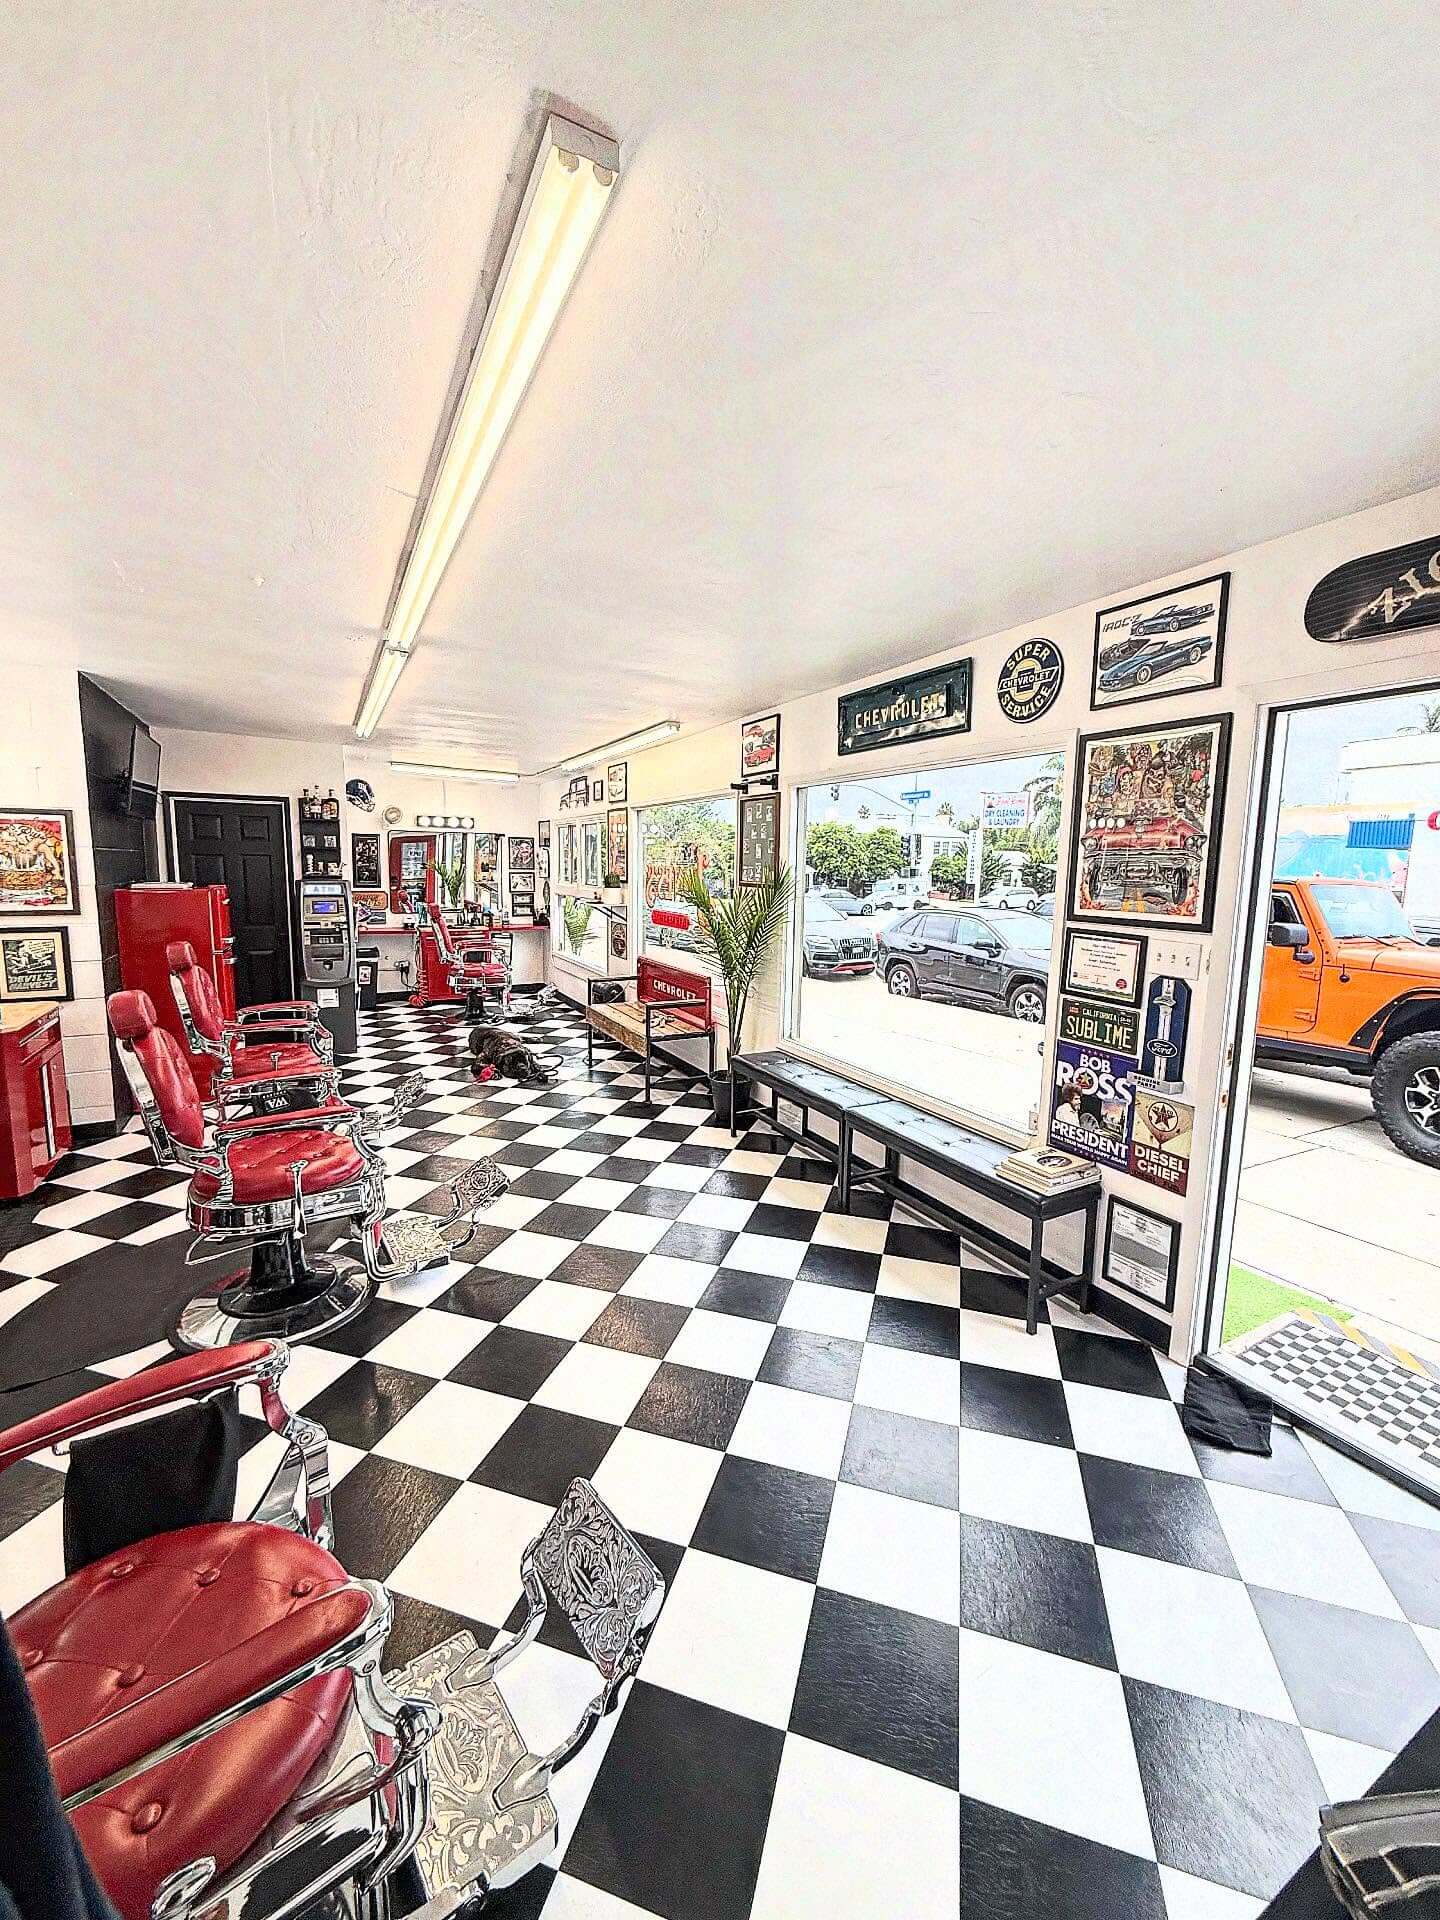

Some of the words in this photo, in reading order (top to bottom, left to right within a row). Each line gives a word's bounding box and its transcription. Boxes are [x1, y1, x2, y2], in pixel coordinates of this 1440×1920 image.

[1006, 644, 1050, 670] SUPER
[1002, 671, 1051, 689] CHEVROLET
[1001, 685, 1051, 717] SERVICE
[984, 809, 995, 818] DRY
[996, 809, 1025, 818] CLEANING
[994, 818, 1020, 826] LAUNDRY
[653, 979, 696, 1000] CHEVROLET
[1082, 1008, 1117, 1021] CALIFORNIA
[1066, 1015, 1134, 1049] SUBLIME
[1151, 1042, 1173, 1055] Ford
[1080, 1054, 1111, 1073] BOB
[1055, 1060, 1132, 1105] ROSS
[1137, 1080, 1156, 1089] PARTS
[1051, 1119, 1128, 1159] PRESIDENT
[1134, 1144, 1186, 1174] DIESEL
[1137, 1159, 1180, 1183] CHIEF
